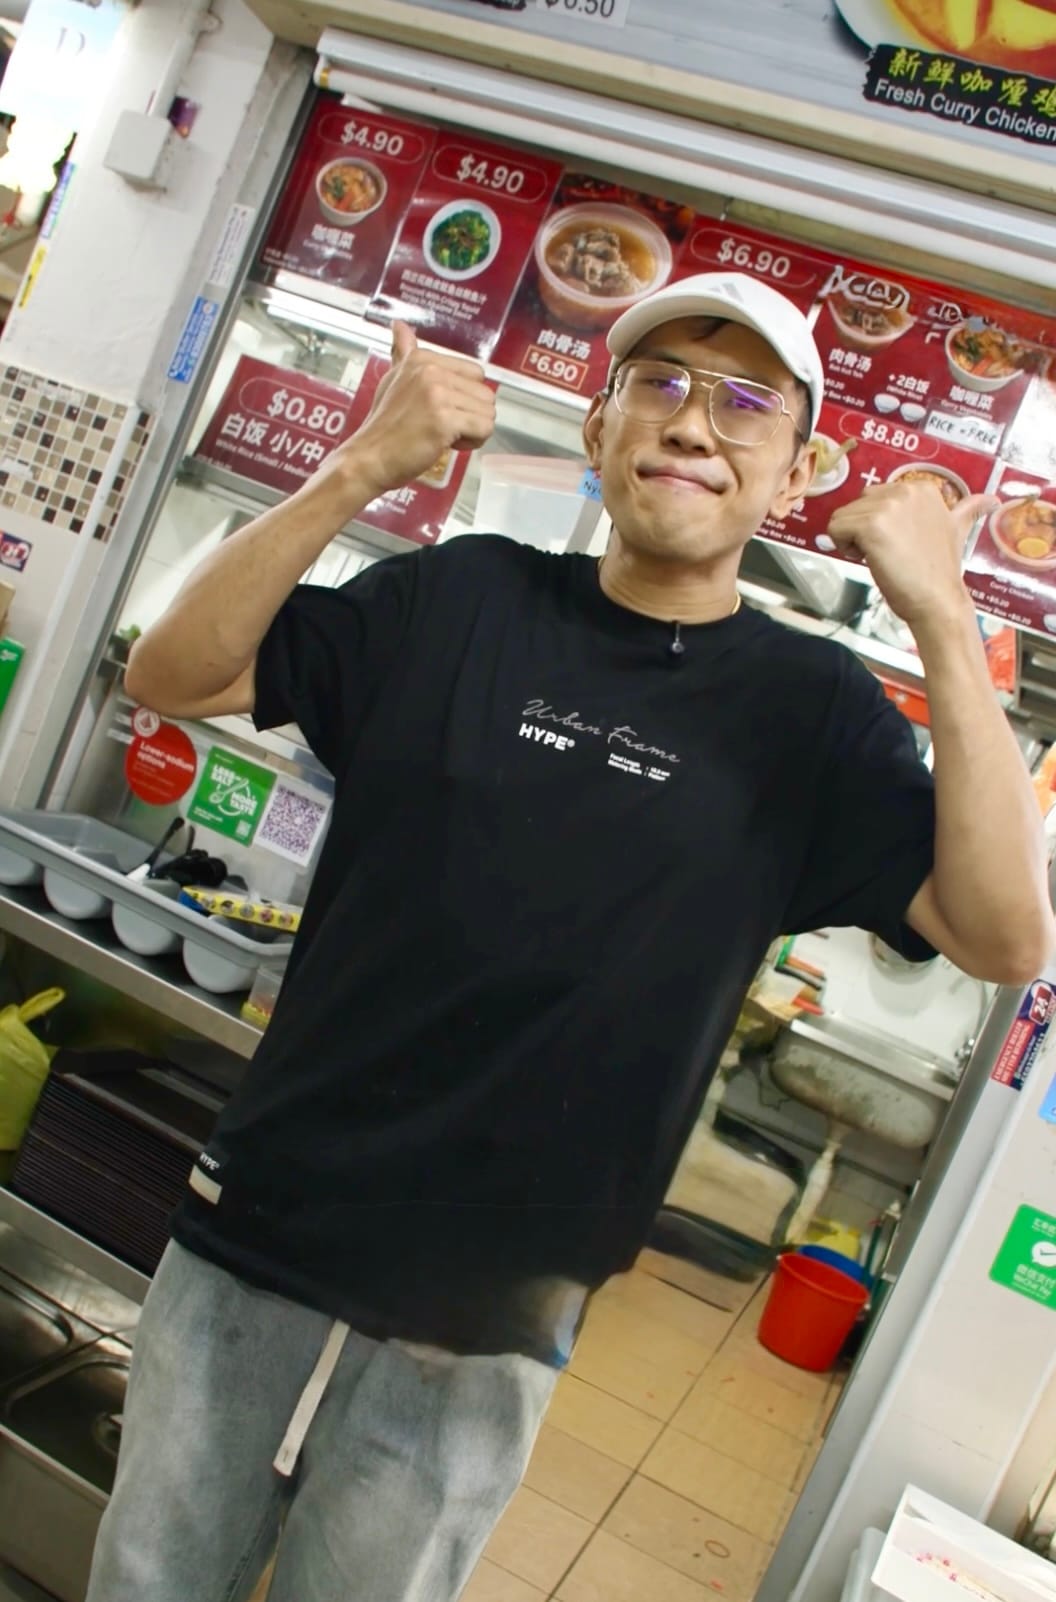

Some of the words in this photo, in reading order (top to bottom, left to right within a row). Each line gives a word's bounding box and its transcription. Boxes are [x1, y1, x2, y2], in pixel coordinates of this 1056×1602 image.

[874, 78, 926, 107] Fresh
[930, 93, 981, 125] Curry
[985, 106, 1056, 140] Chicken
[340, 120, 404, 156] $4.90
[456, 153, 525, 194] $4.90
[716, 237, 791, 279] $6.90
[536, 329, 592, 360] 肉骨汤
[529, 351, 579, 383] $6.90
[220, 412, 270, 447] 白饭
[267, 389, 347, 436] $0.80
[929, 415, 955, 433] RICE
[860, 418, 920, 452] $8.80
[989, 581, 1008, 594] Curry
[1008, 587, 1035, 601] Chicken
[522, 698, 603, 736] Urban
[140, 741, 195, 773] Lower-sodium
[607, 725, 681, 764] Frame
